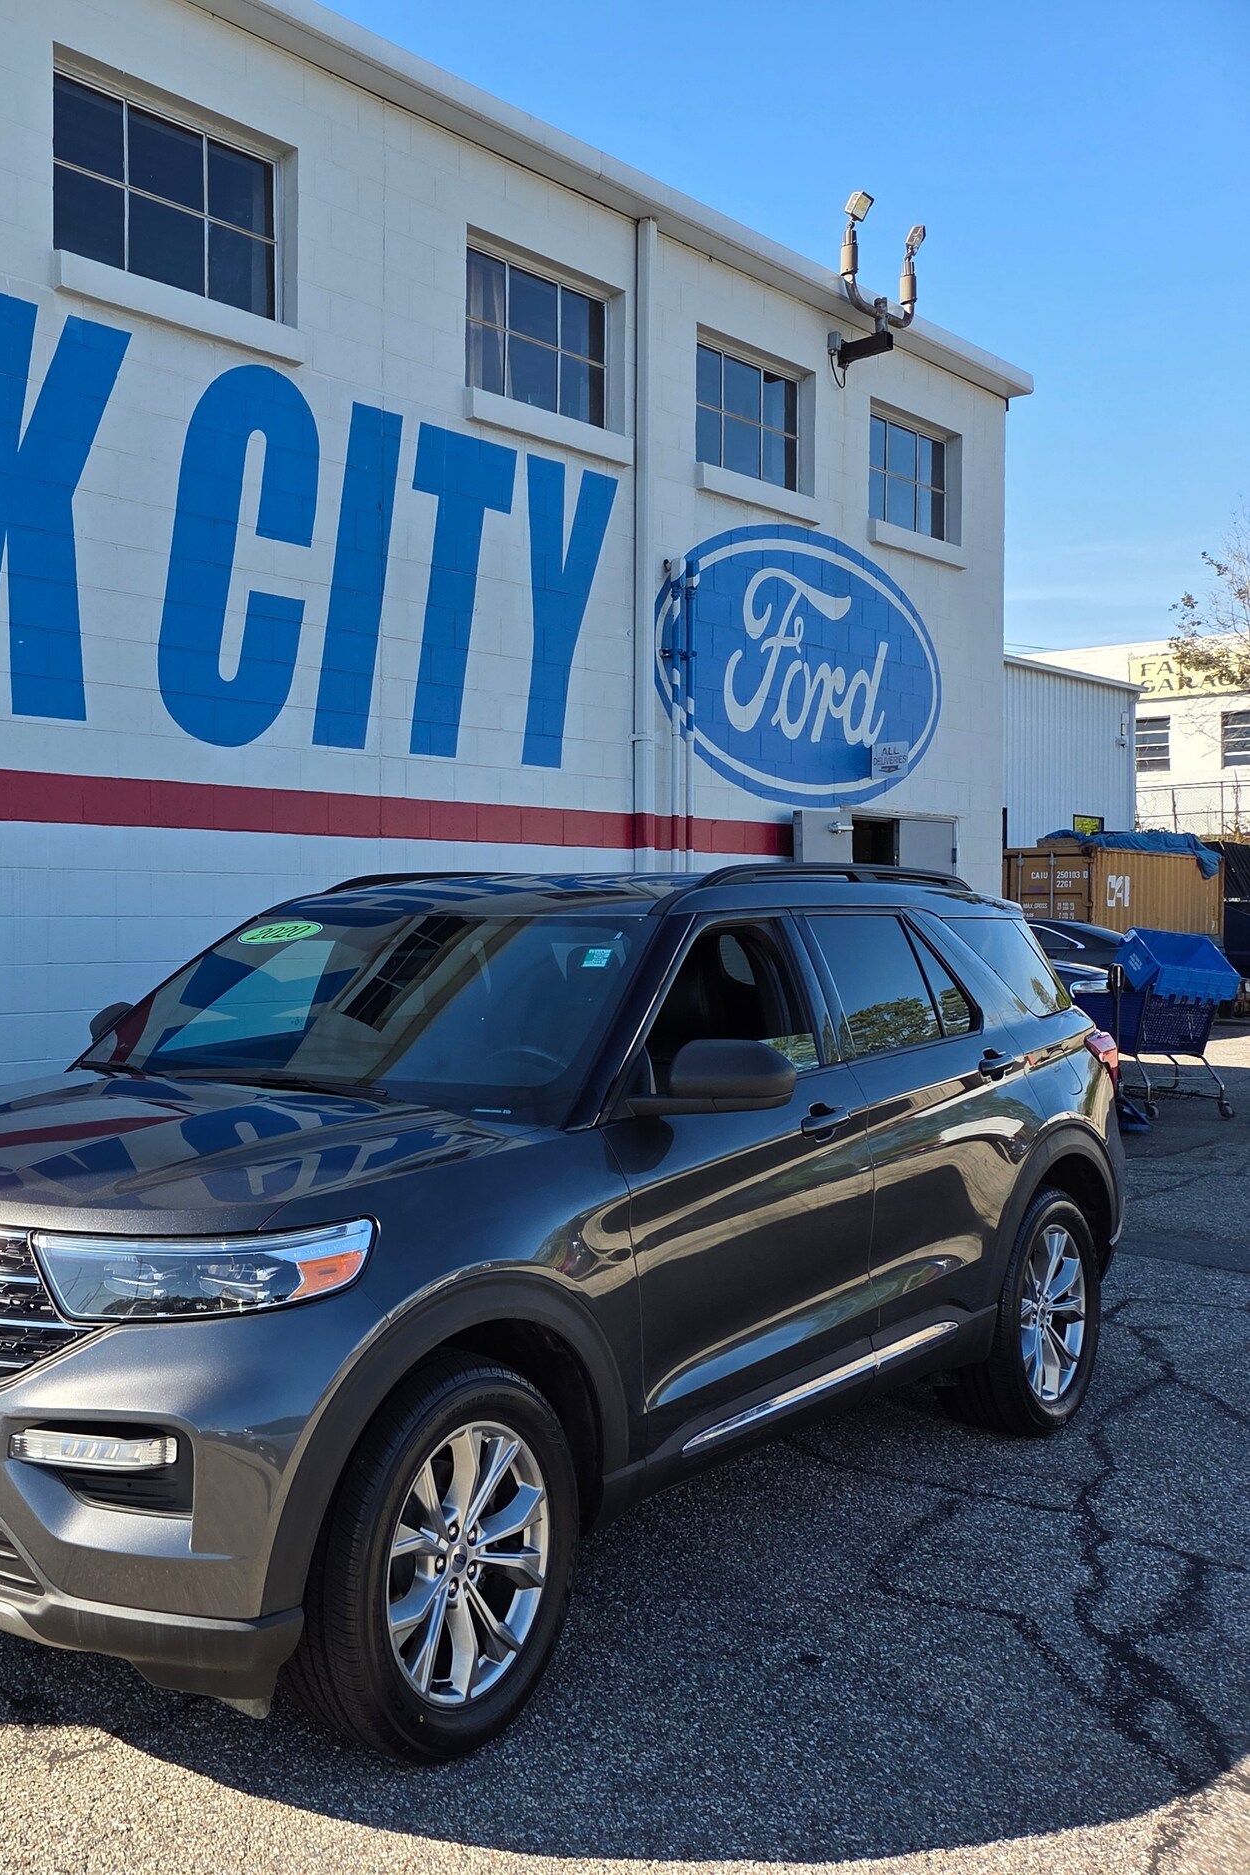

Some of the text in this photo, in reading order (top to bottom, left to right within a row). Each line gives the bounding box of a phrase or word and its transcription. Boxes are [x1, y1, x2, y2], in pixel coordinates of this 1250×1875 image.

[157, 364, 618, 767] CITY
[723, 567, 888, 748] Ford
[881, 746, 900, 756] ALL
[873, 754, 907, 766] DELIVERIES
[1031, 871, 1048, 880] CAIU
[1056, 870, 1080, 879] 250103
[1056, 880, 1072, 888] 22G1
[1106, 875, 1130, 907] CAI
[246, 925, 311, 940] 2020
